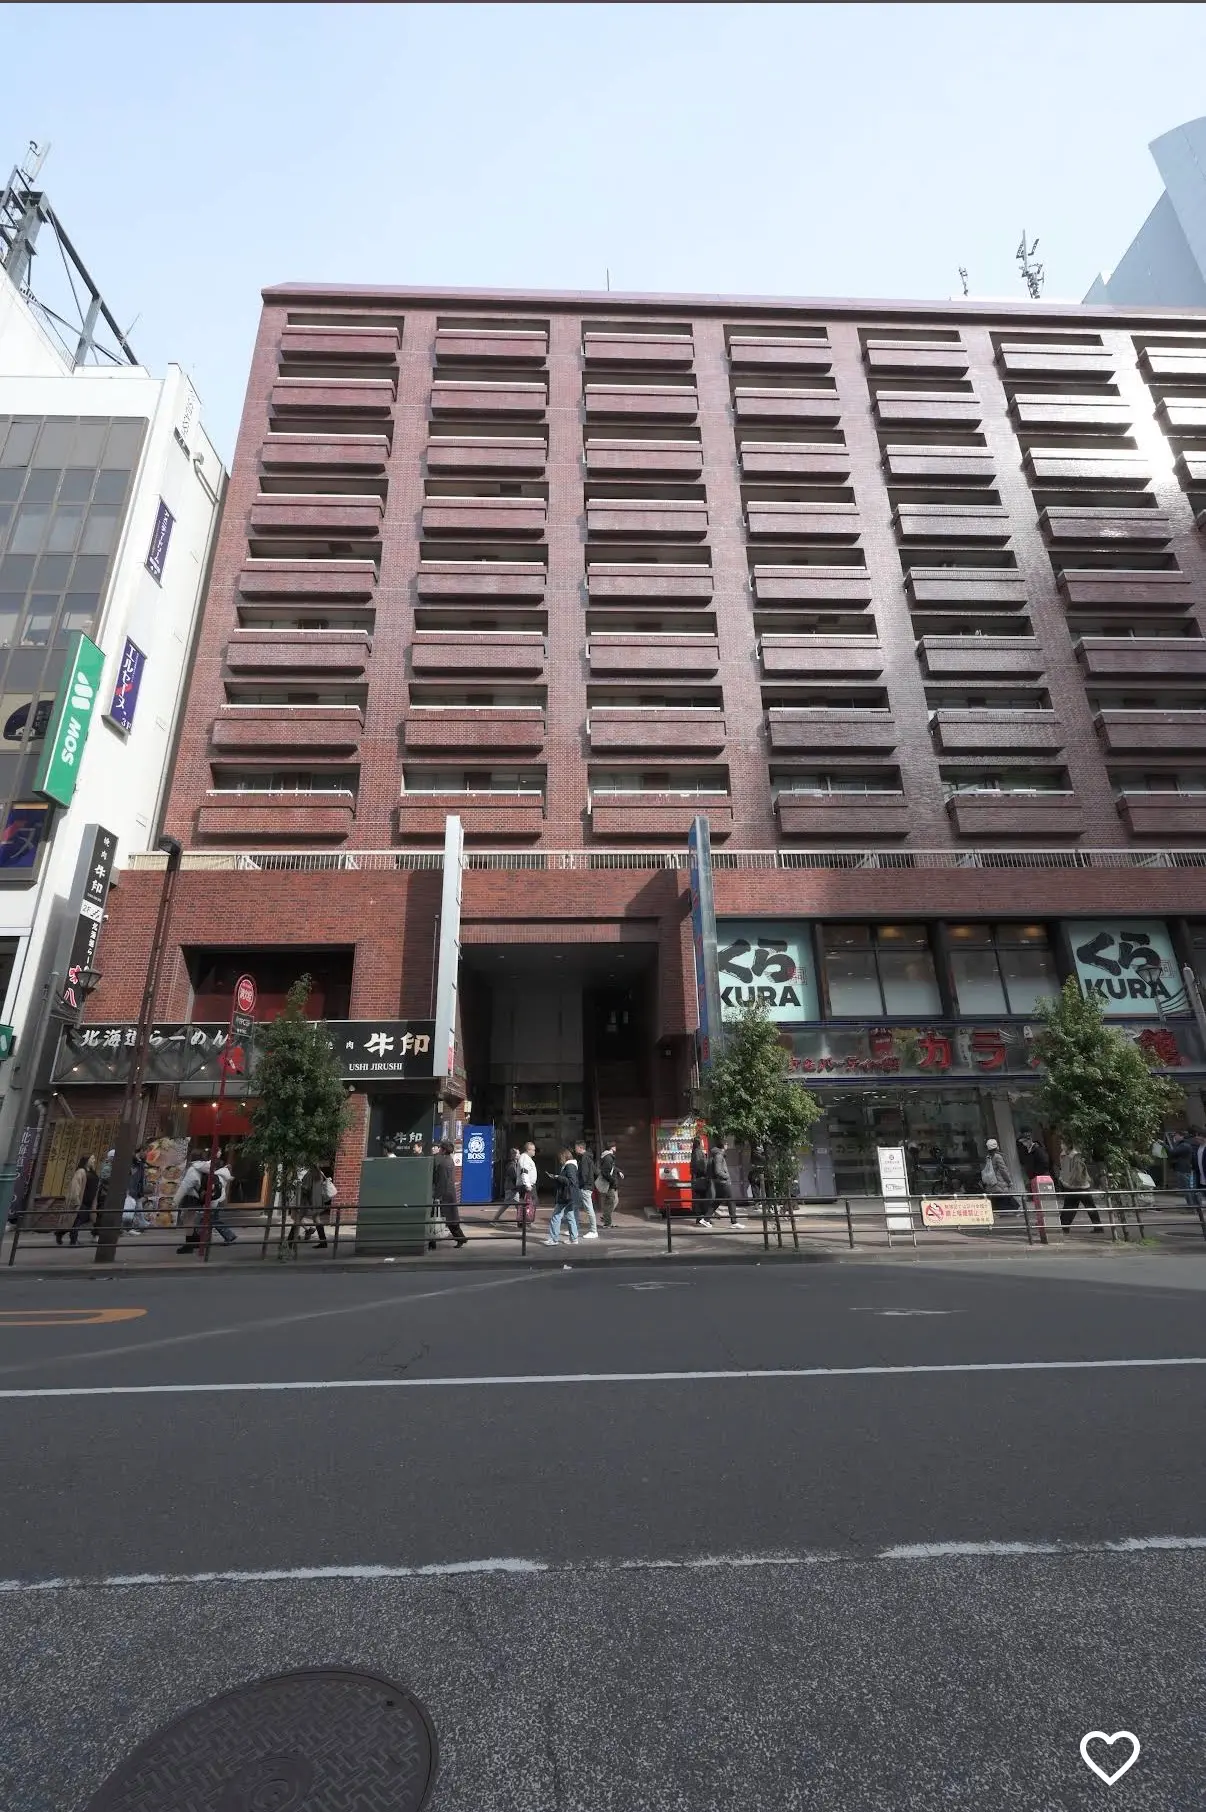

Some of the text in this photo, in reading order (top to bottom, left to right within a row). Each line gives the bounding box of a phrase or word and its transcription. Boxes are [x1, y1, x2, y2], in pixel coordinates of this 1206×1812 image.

[61, 716, 82, 767] MOS
[718, 938, 796, 984] くら
[1077, 931, 1161, 976] くら
[720, 986, 802, 1008] KURA
[1084, 978, 1172, 1000] KURA
[363, 1032, 431, 1058] 牛印
[349, 1062, 403, 1071] USHI JIRUSHI
